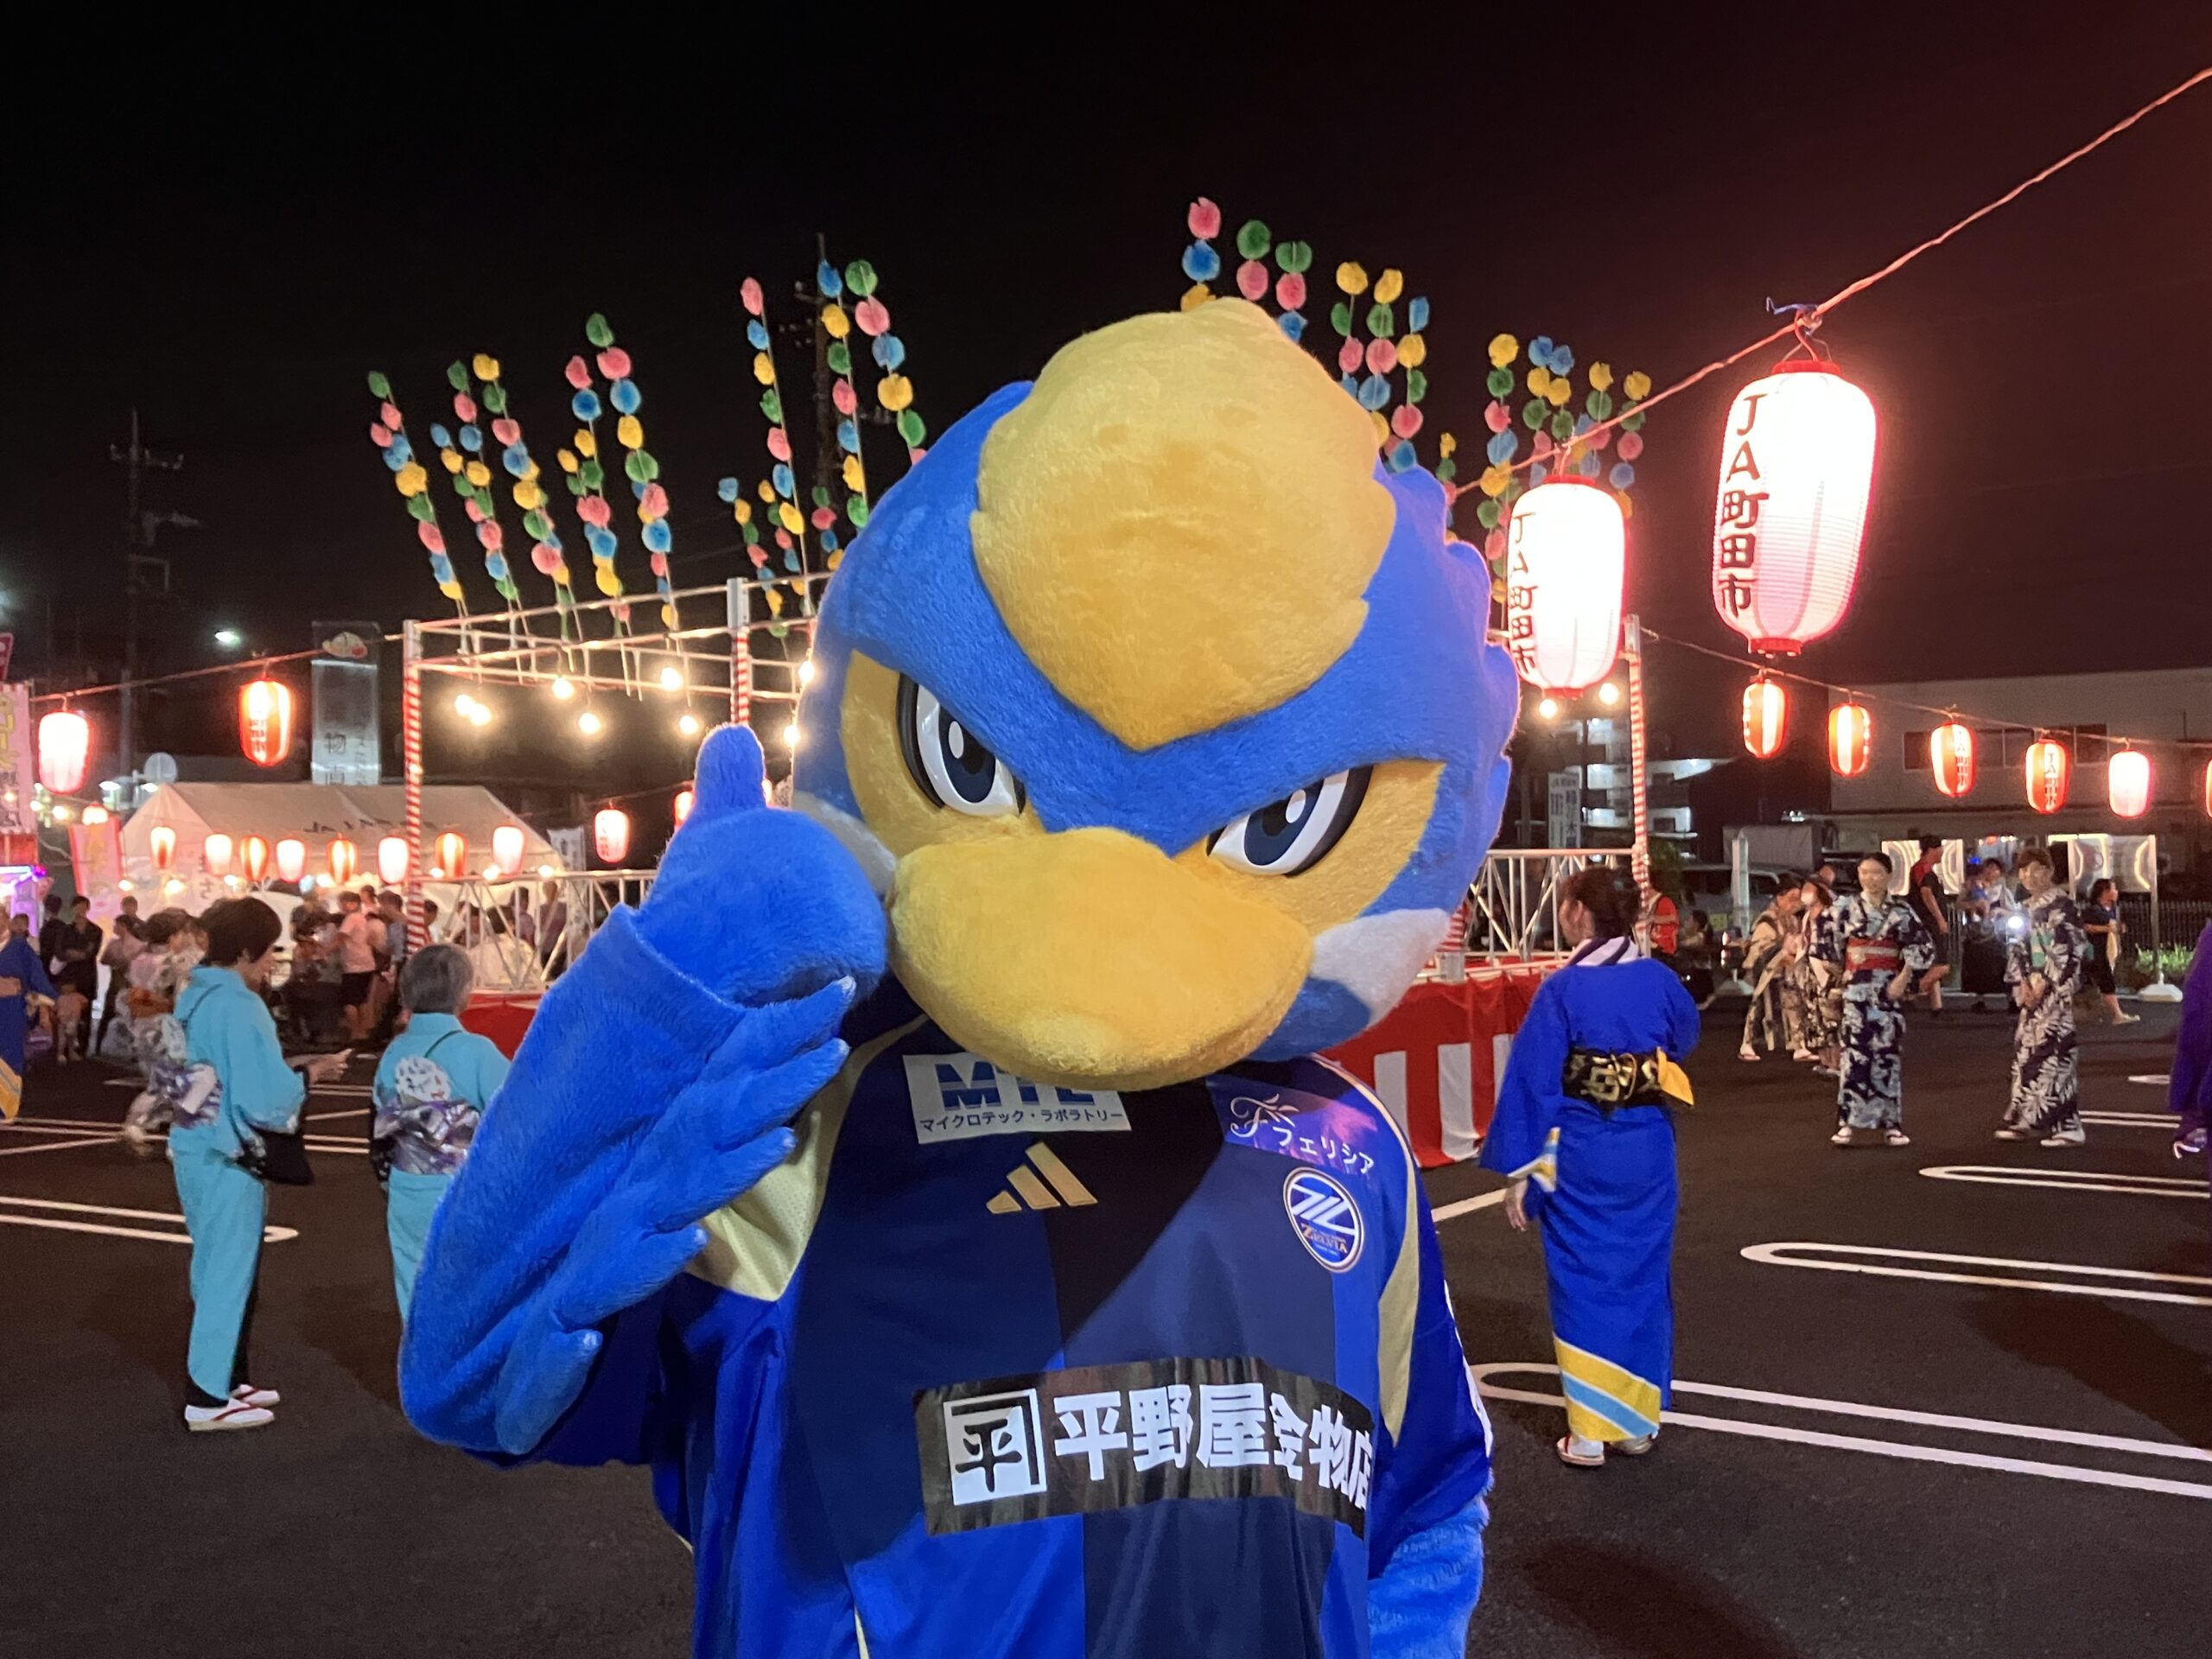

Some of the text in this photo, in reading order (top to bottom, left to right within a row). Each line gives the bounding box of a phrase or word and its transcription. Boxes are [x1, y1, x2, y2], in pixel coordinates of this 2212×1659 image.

[1719, 393, 1770, 619] JA町田市
[1273, 1126, 1376, 1174] フェリシア
[1053, 1382, 1373, 1510] 平野屋金物店
